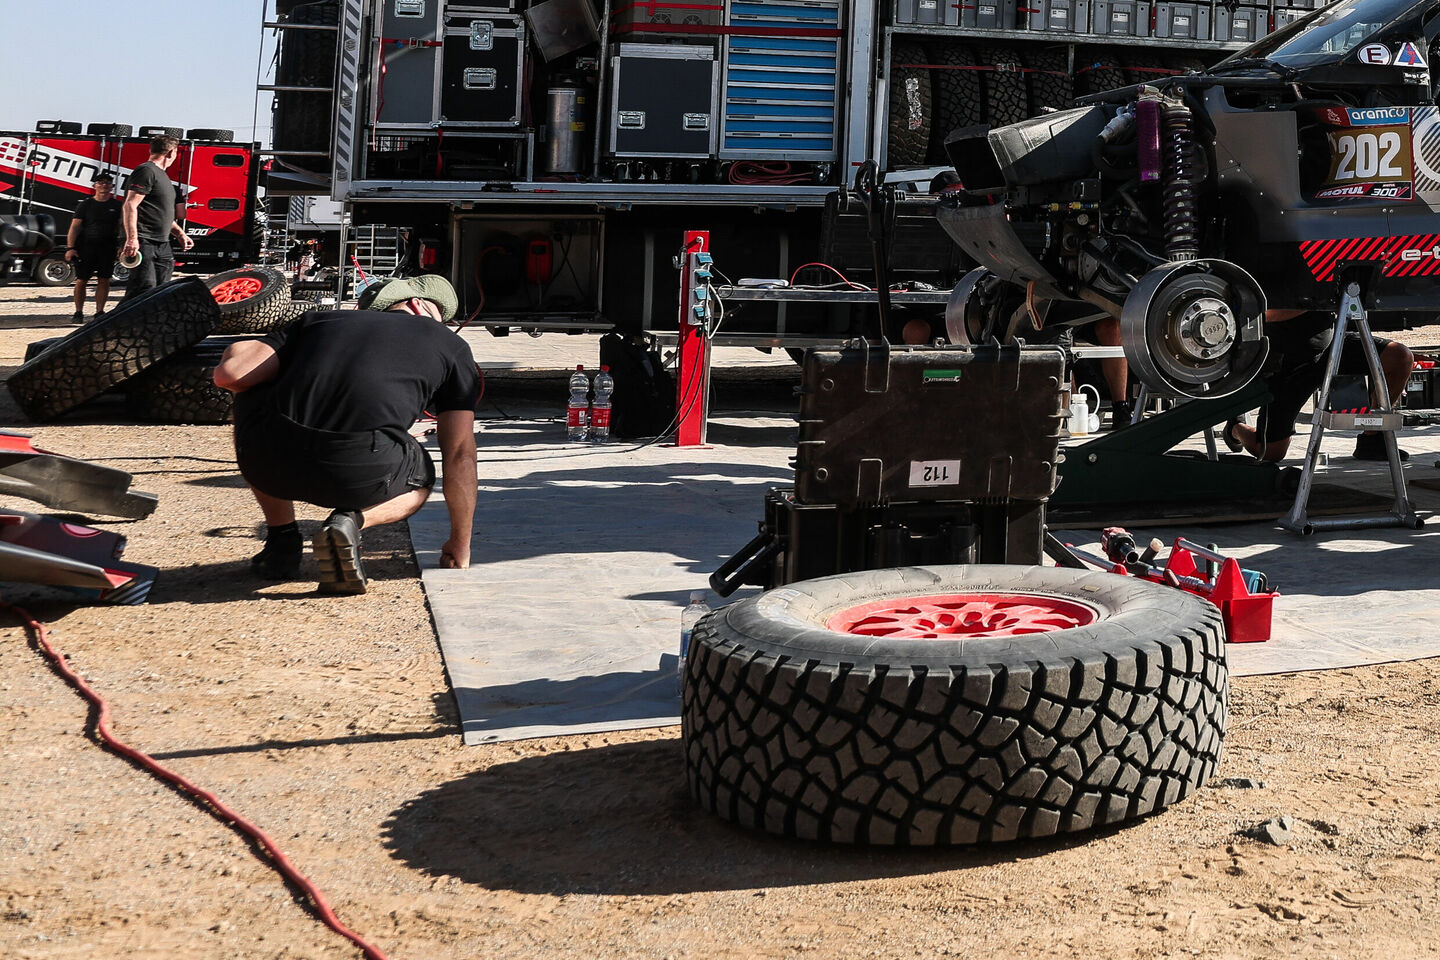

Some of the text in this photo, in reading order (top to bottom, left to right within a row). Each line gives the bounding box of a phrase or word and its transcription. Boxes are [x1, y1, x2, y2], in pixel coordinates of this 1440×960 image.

[1366, 47, 1383, 63] E
[1351, 107, 1406, 120] aramco
[1334, 132, 1403, 180] 202
[1319, 186, 1364, 197] MOTUL
[1371, 187, 1409, 197] 300V
[923, 466, 949, 481] 112
